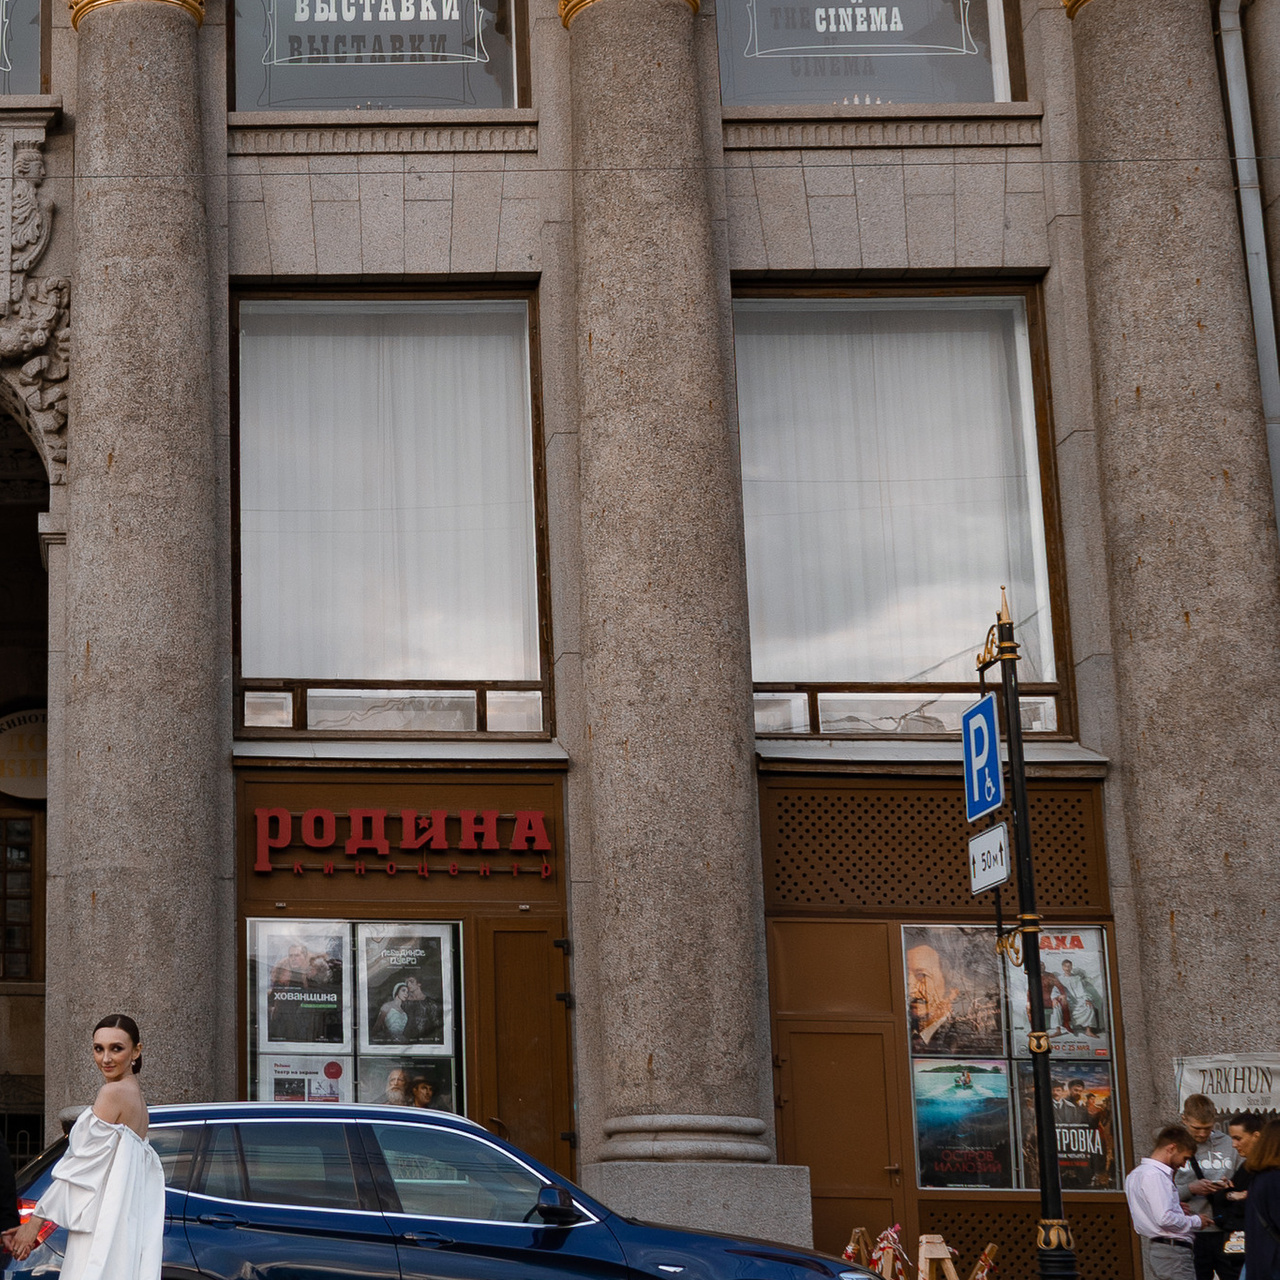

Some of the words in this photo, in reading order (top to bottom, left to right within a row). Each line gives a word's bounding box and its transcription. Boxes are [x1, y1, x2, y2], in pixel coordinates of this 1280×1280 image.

[814, 6, 904, 33] CINEMA
[7, 733, 47, 755] ДО
[254, 807, 552, 872] РОДИНА
[293, 860, 553, 879] киноцентр
[1199, 1067, 1273, 1094] TARKHUN
[1055, 1129, 1103, 1155] ТРОВКА
[942, 1150, 994, 1162] ОСТРОВ
